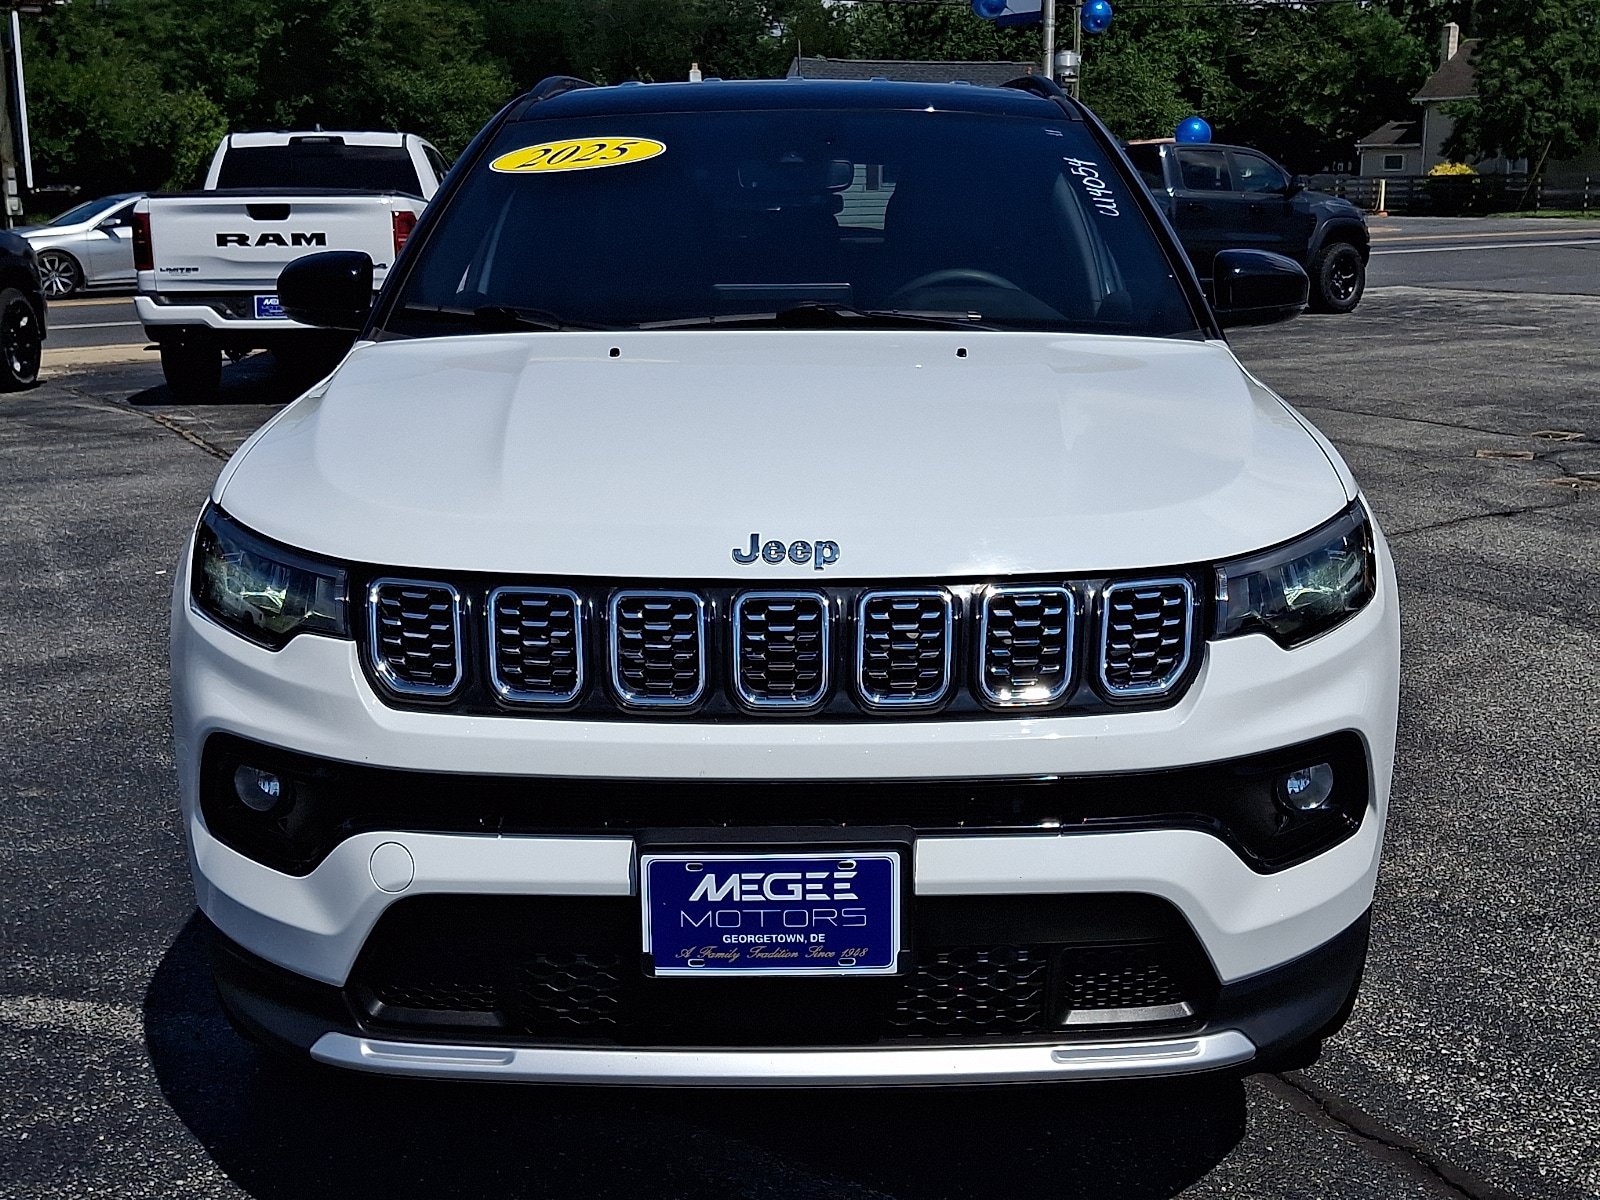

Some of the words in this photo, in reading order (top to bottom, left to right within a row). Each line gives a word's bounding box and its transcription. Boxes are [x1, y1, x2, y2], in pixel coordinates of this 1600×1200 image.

[514, 141, 641, 169] 2025
[216, 233, 327, 247] RAM
[732, 533, 840, 570] Jeep
[689, 872, 858, 901] MEGEE
[681, 908, 867, 928] MOTORS
[722, 934, 807, 944] GEORGETOWN,
[810, 933, 826, 943] DE
[697, 946, 740, 963] Family
[747, 945, 799, 959] Tradition
[804, 945, 835, 958] Since
